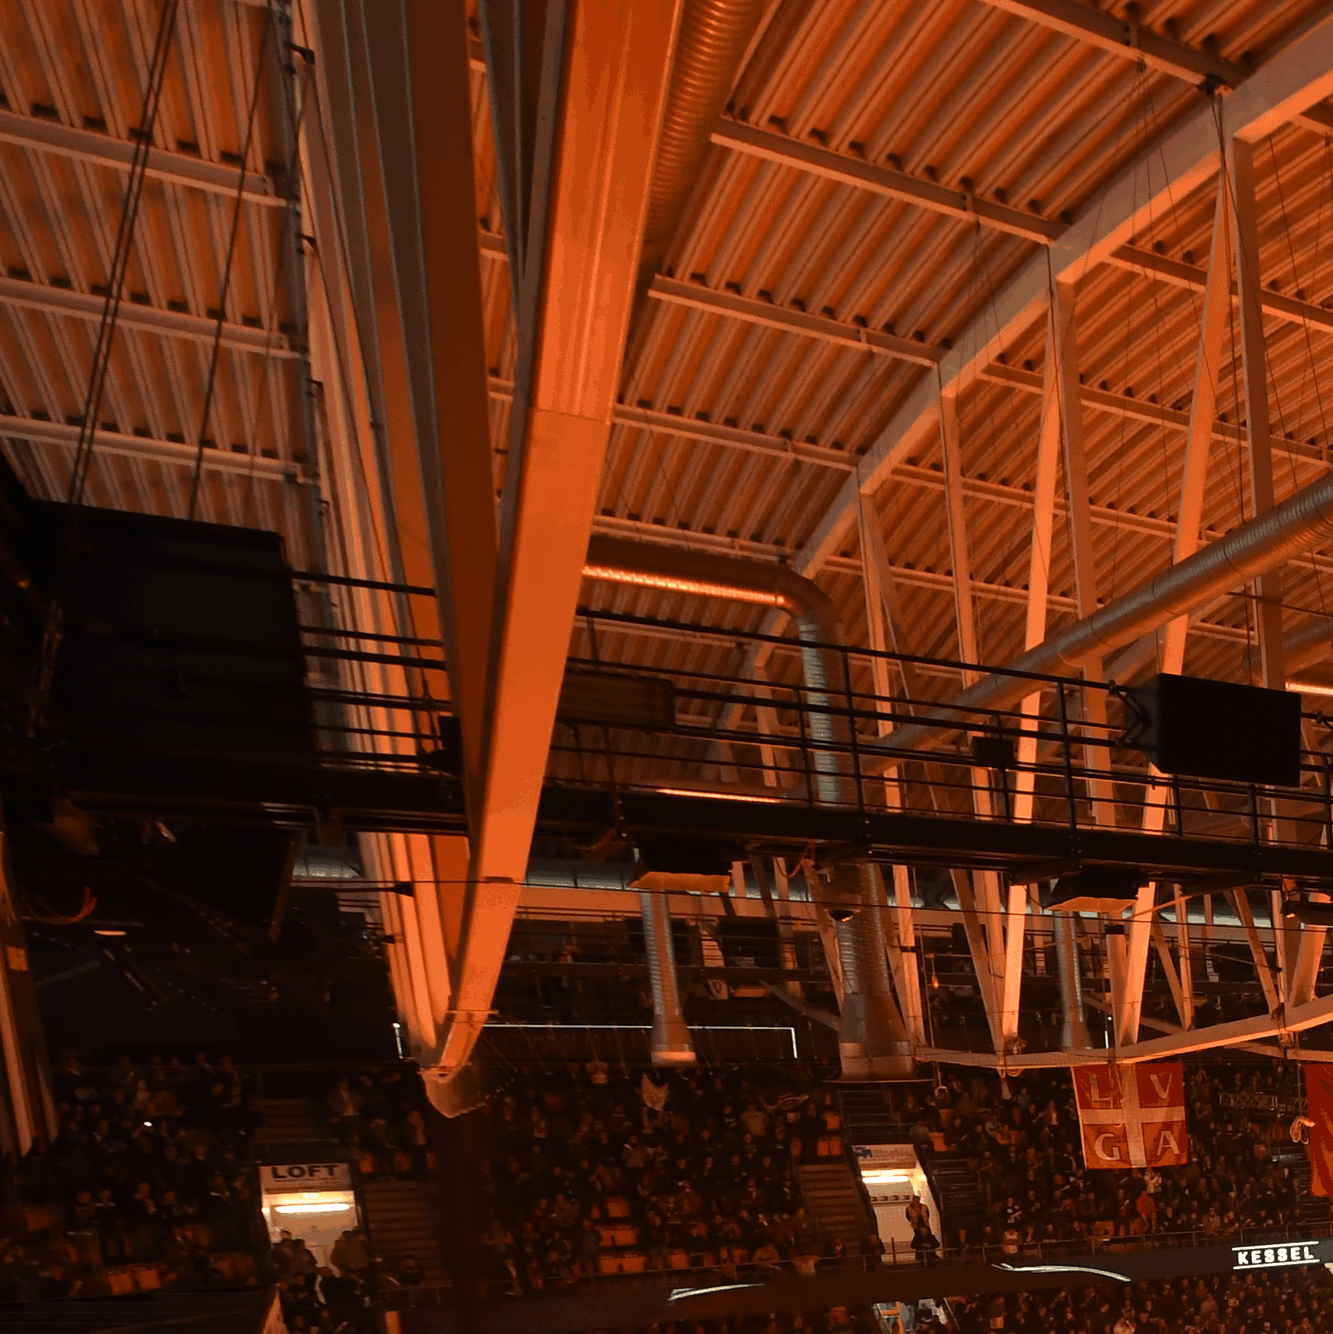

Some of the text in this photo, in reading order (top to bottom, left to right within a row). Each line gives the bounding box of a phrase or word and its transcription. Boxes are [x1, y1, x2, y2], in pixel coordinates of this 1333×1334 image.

[1090, 1073, 1174, 1101] L V
[1094, 1130, 1180, 1161] G A
[271, 1164, 338, 1179] LOFT
[1237, 1245, 1315, 1266] KESSEL
